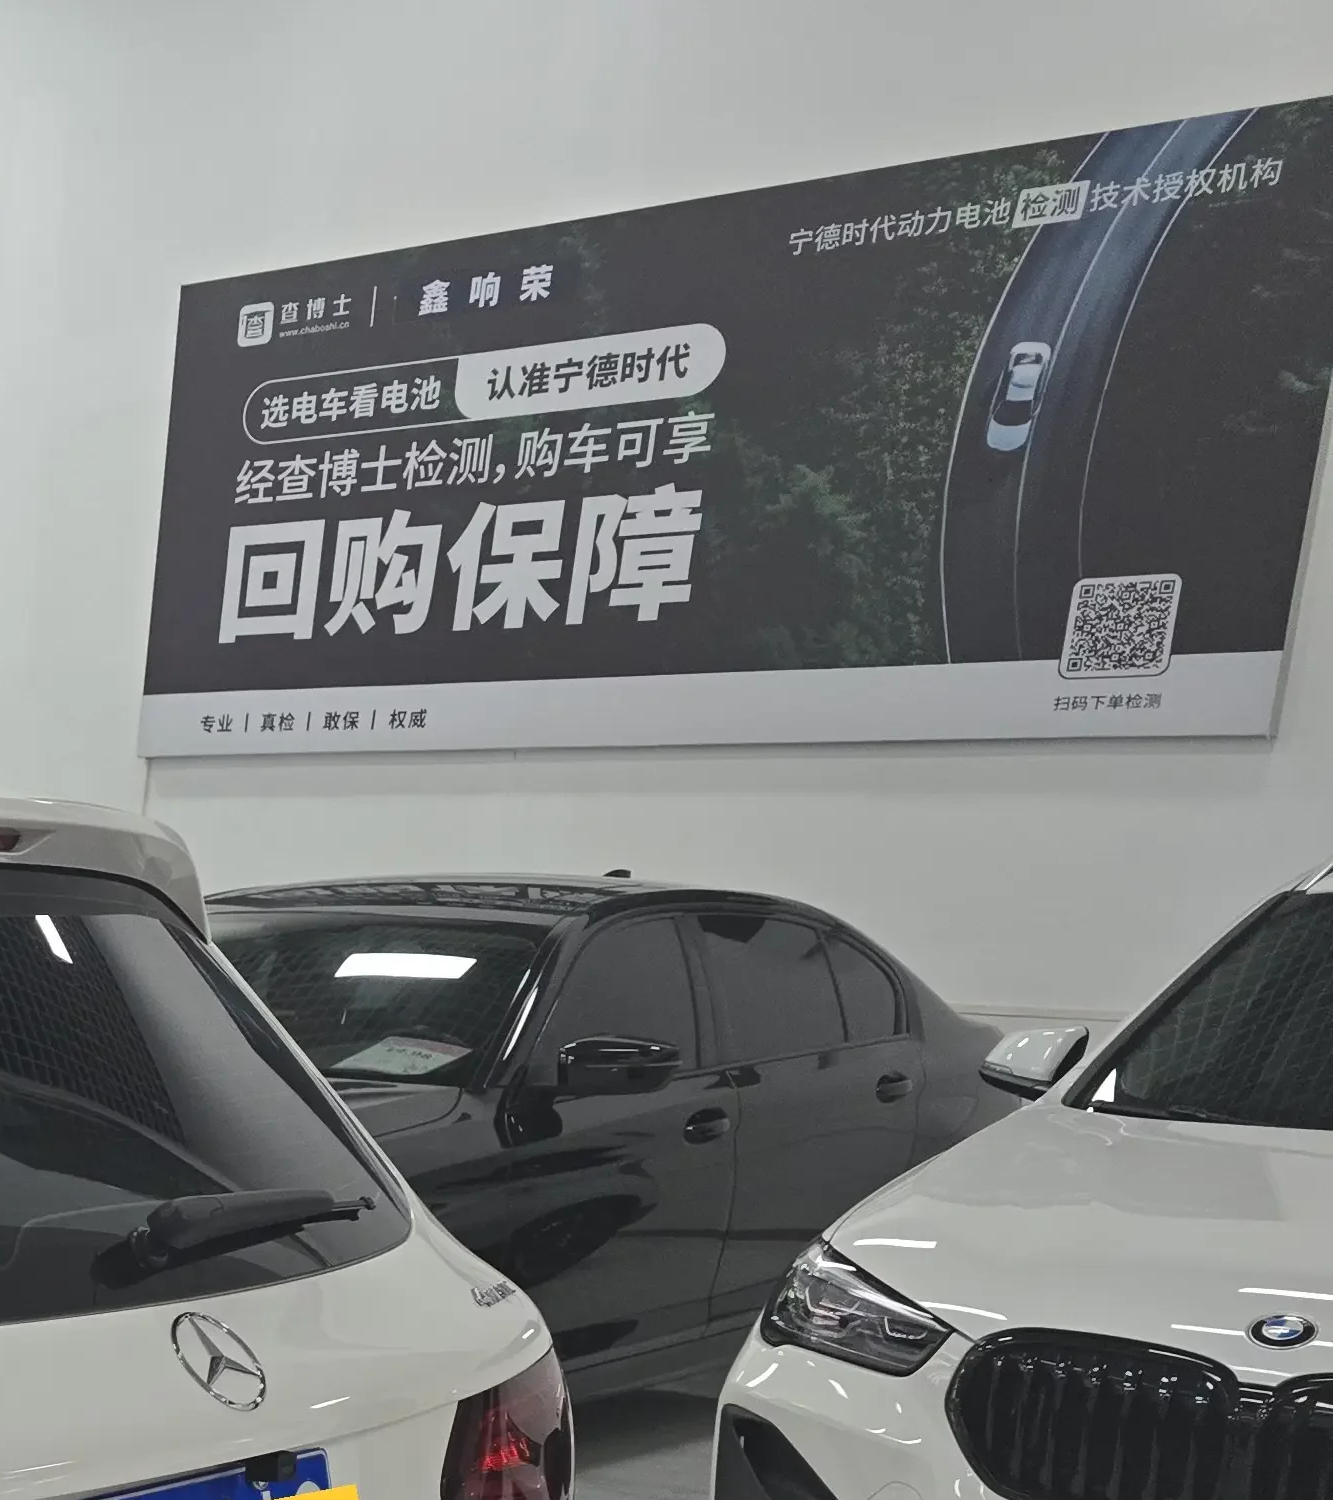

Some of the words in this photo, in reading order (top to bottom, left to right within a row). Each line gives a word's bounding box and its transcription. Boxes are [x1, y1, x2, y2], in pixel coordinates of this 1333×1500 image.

[787, 157, 1284, 257] 宁德时代动力电池检测技术授权机构
[280, 293, 353, 325] 查博士
[417, 263, 554, 318] 鑫响荣
[278, 320, 351, 338] www.chaboshi.cn
[259, 374, 443, 430] 选电车看电池
[485, 342, 692, 402] 认准宁德时代
[217, 482, 703, 645] 回购保障
[199, 712, 233, 734] 专业
[259, 711, 295, 733] 真检
[322, 709, 360, 732] 敢保
[387, 707, 428, 731] 权威
[1053, 692, 1163, 712] 扫码下单检测
